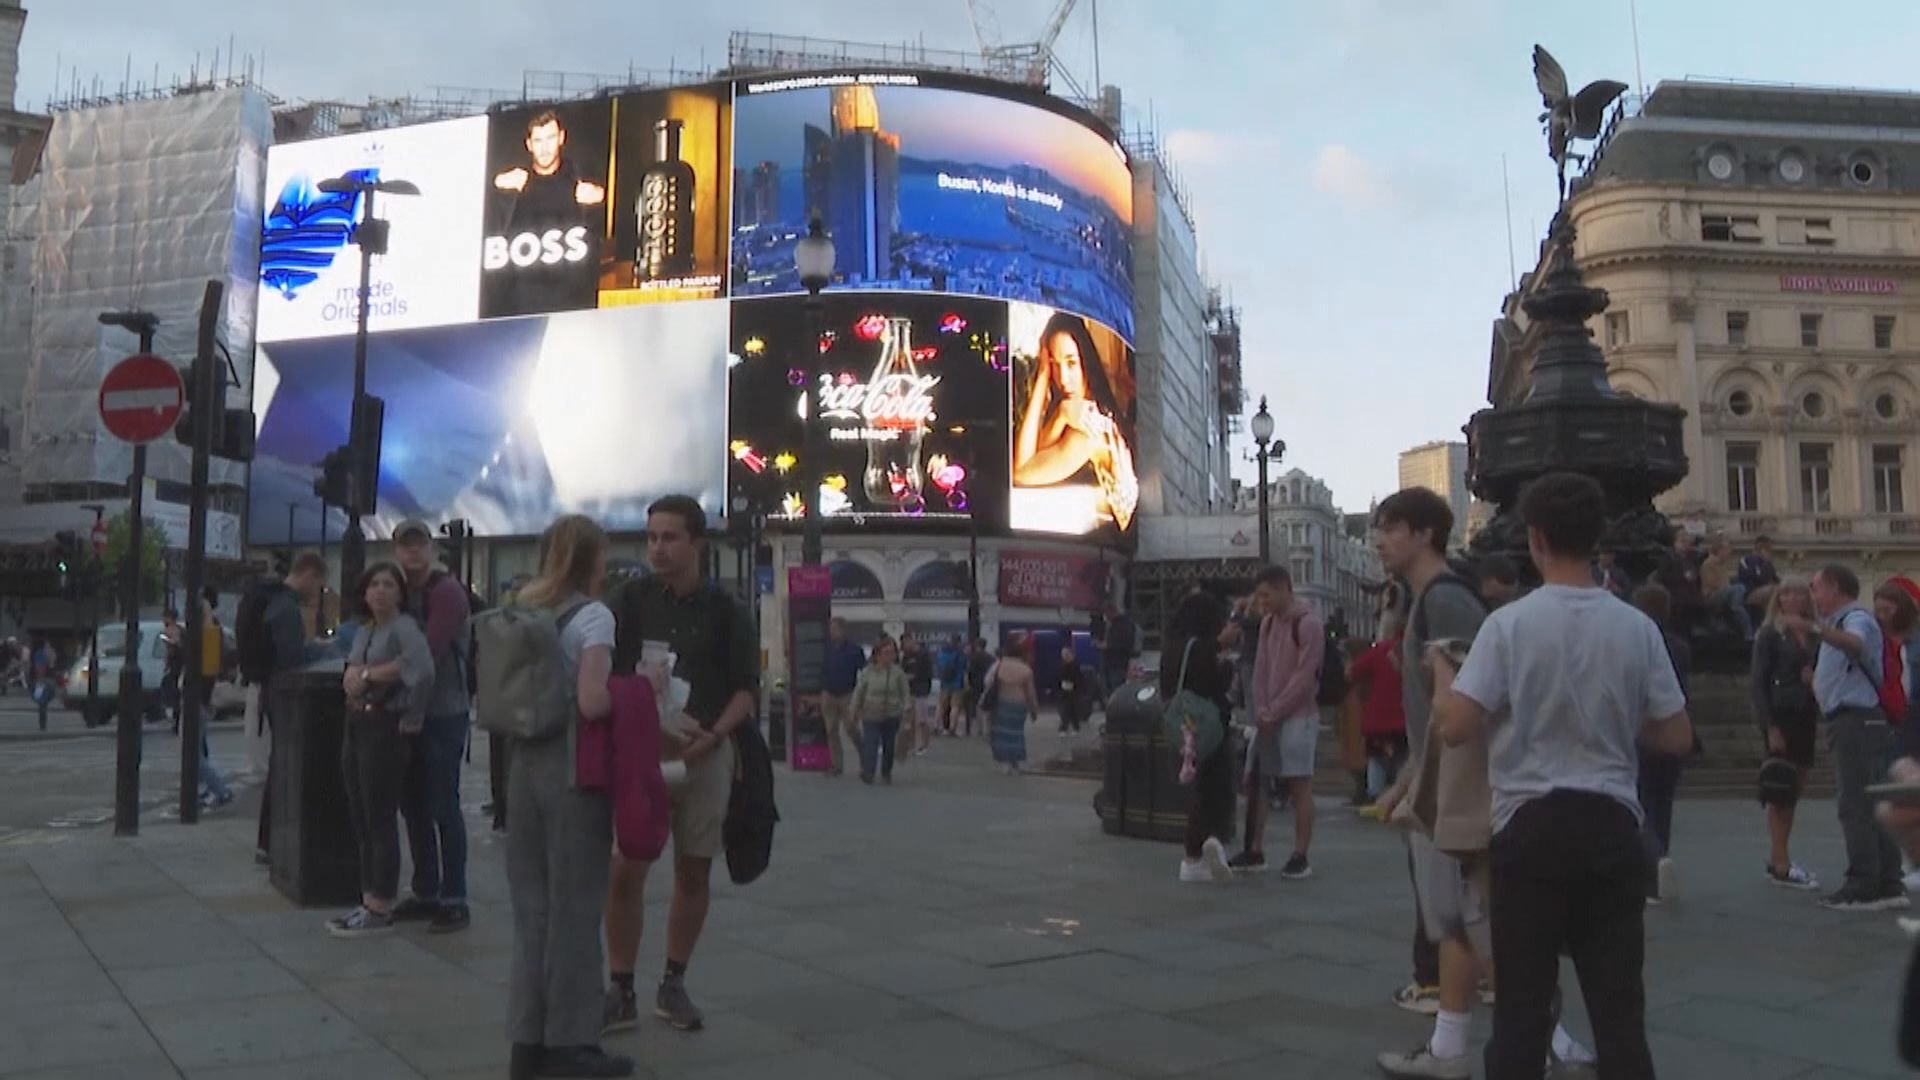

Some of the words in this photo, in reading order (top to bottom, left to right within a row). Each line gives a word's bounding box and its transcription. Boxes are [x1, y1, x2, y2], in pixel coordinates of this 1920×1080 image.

[939, 173, 981, 193] Busan,
[1028, 187, 1063, 211] already
[484, 226, 588, 269] BOSS
[336, 280, 394, 300] mde
[321, 297, 408, 323] Orignals
[831, 428, 859, 439] Real
